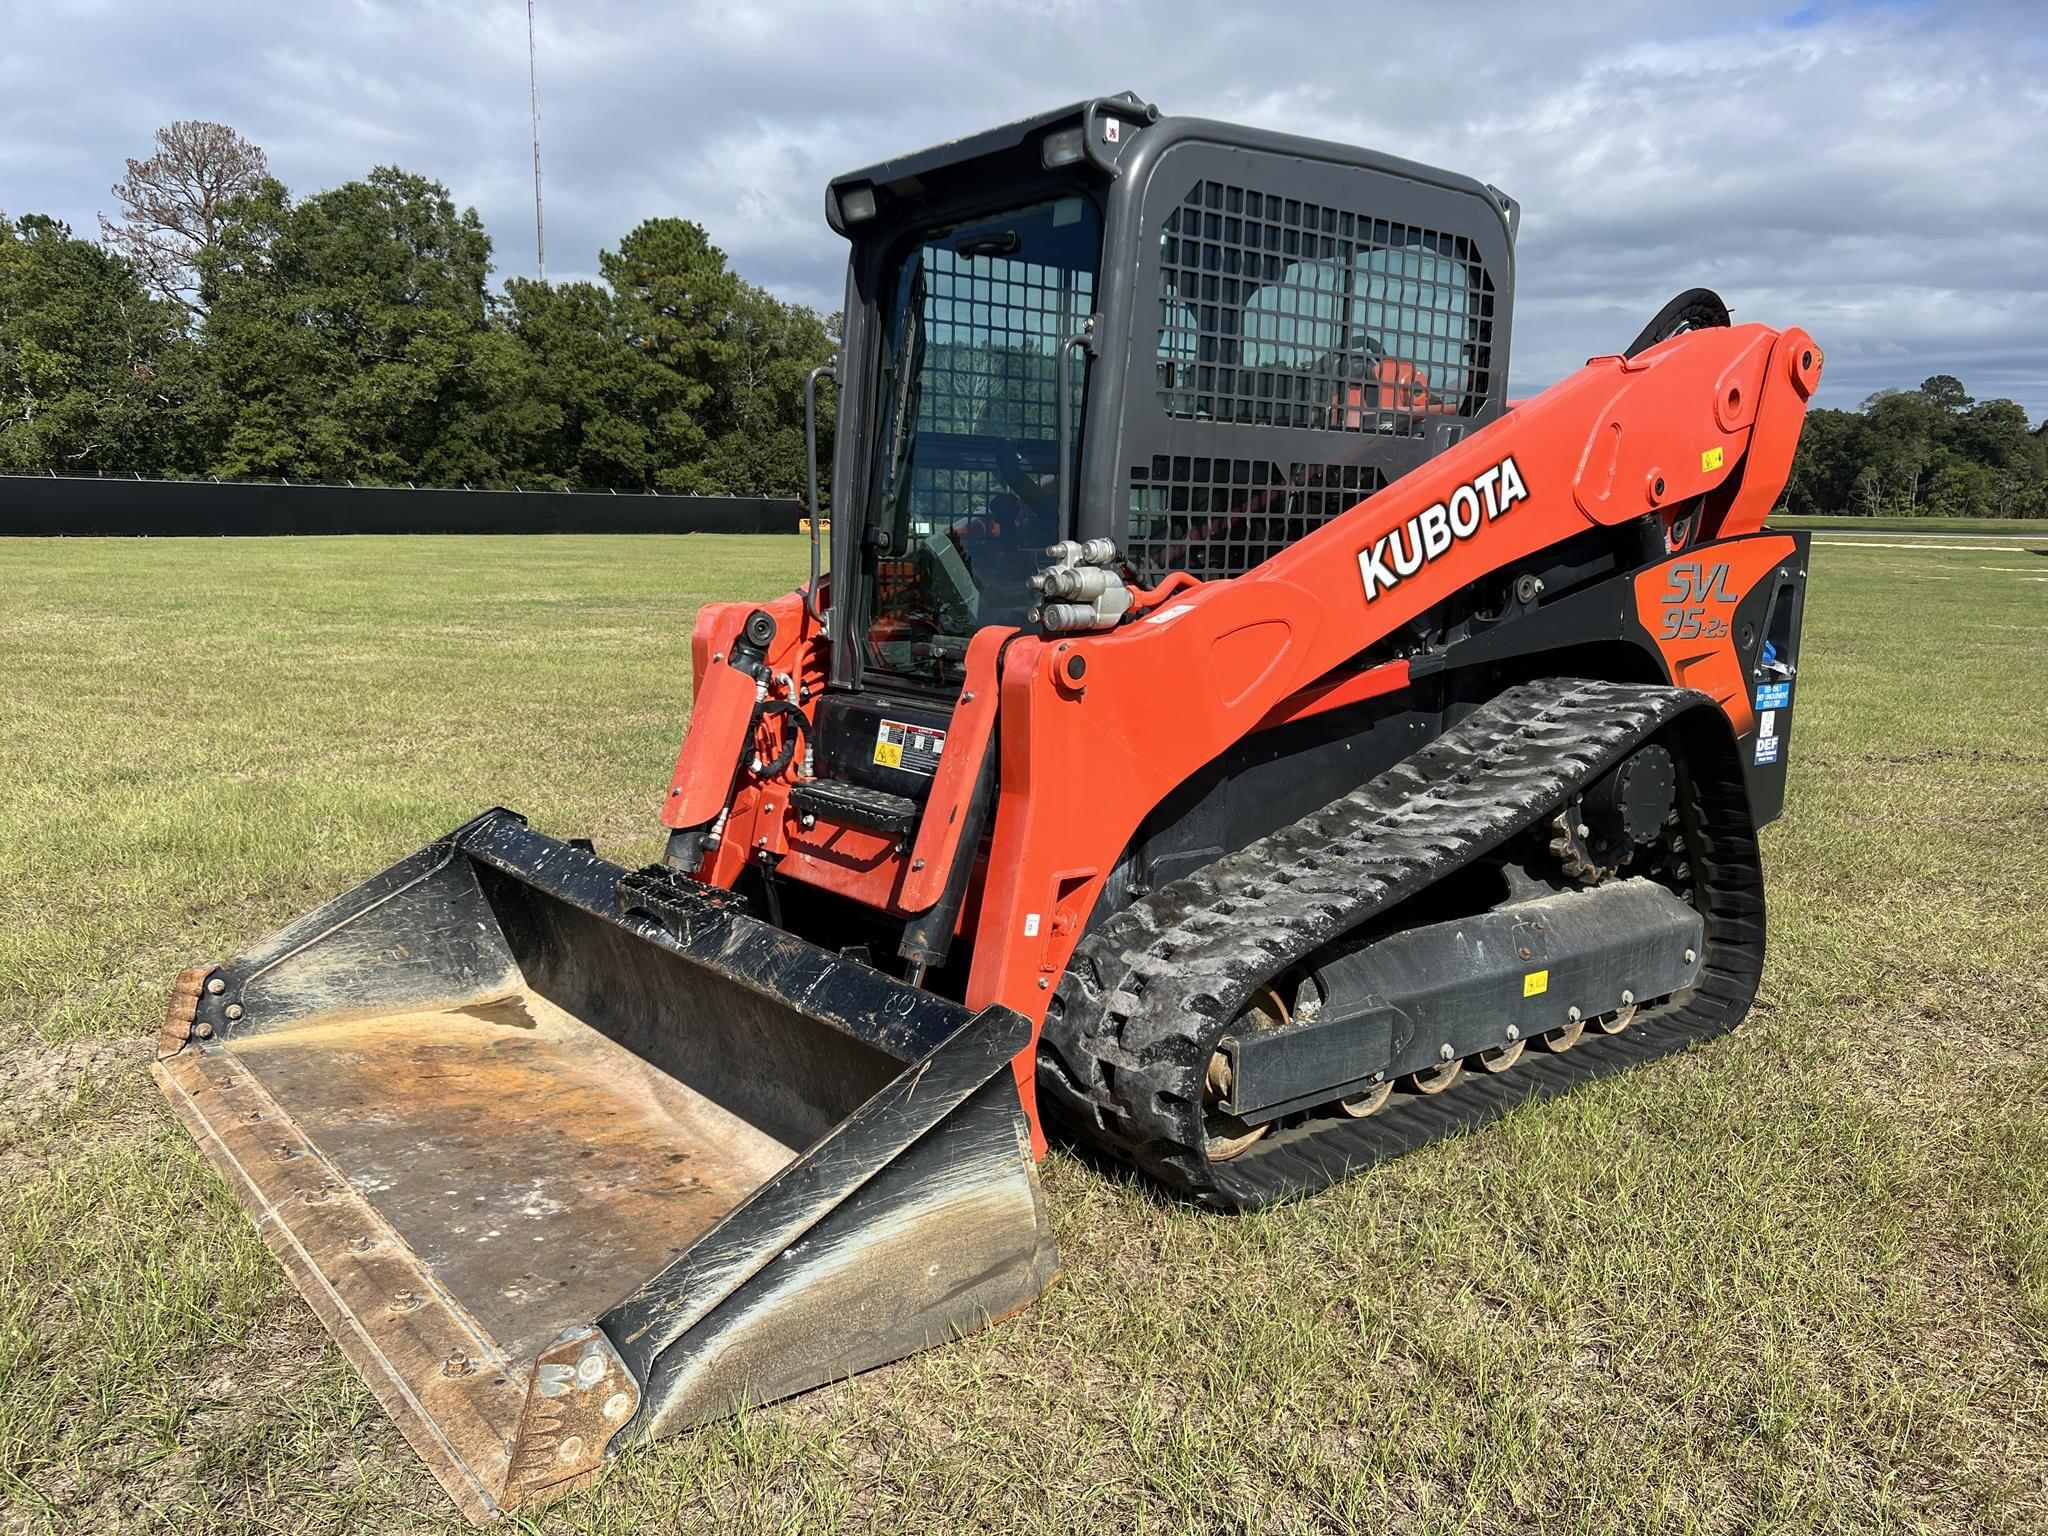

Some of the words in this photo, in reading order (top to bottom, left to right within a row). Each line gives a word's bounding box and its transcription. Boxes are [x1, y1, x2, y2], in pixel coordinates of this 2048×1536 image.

[1357, 456, 1528, 602] KUBOTA
[1661, 563, 1738, 604] SVL
[1756, 737, 1779, 752] DEF
